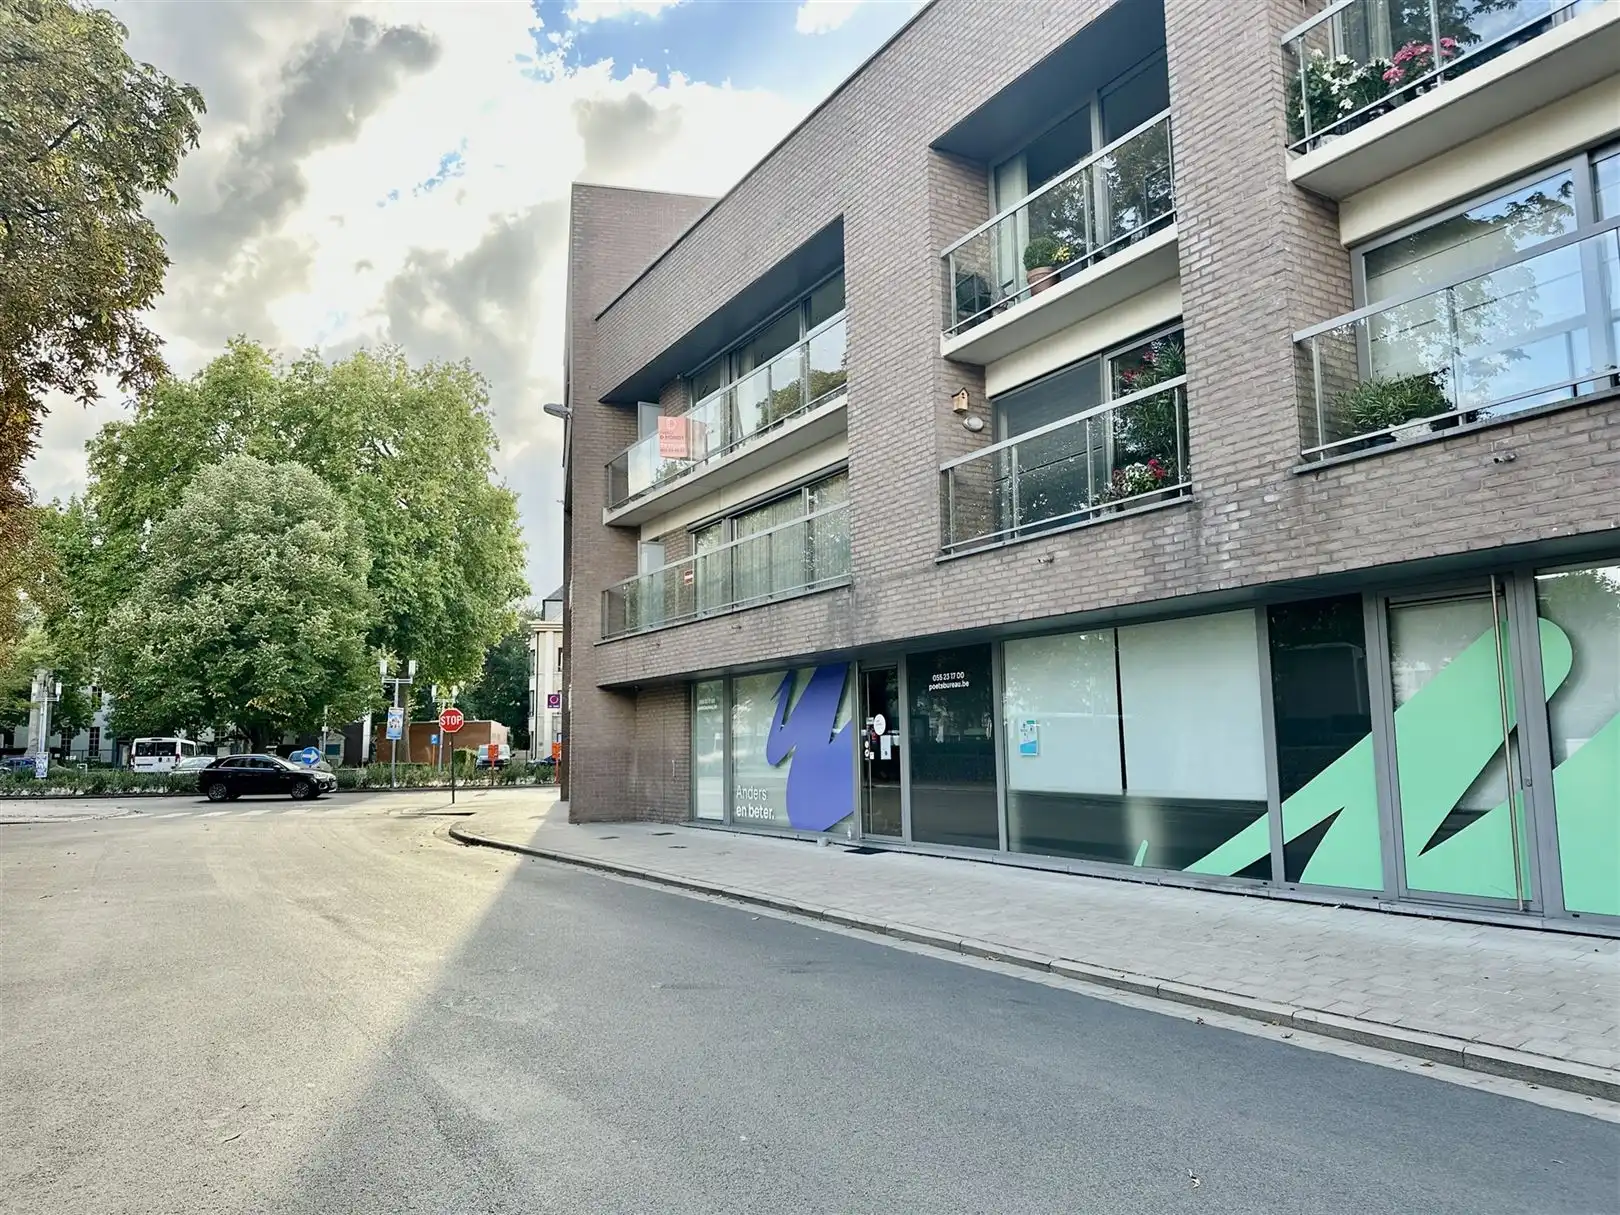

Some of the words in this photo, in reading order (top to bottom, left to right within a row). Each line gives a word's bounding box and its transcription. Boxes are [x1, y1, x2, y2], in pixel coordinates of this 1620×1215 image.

[956, 671, 965, 679] 00
[928, 680, 970, 692] poetsbureau.be
[440, 715, 462, 726] STOP
[736, 784, 767, 801] Anders
[736, 805, 747, 817] en
[748, 803, 775, 820] beter.
